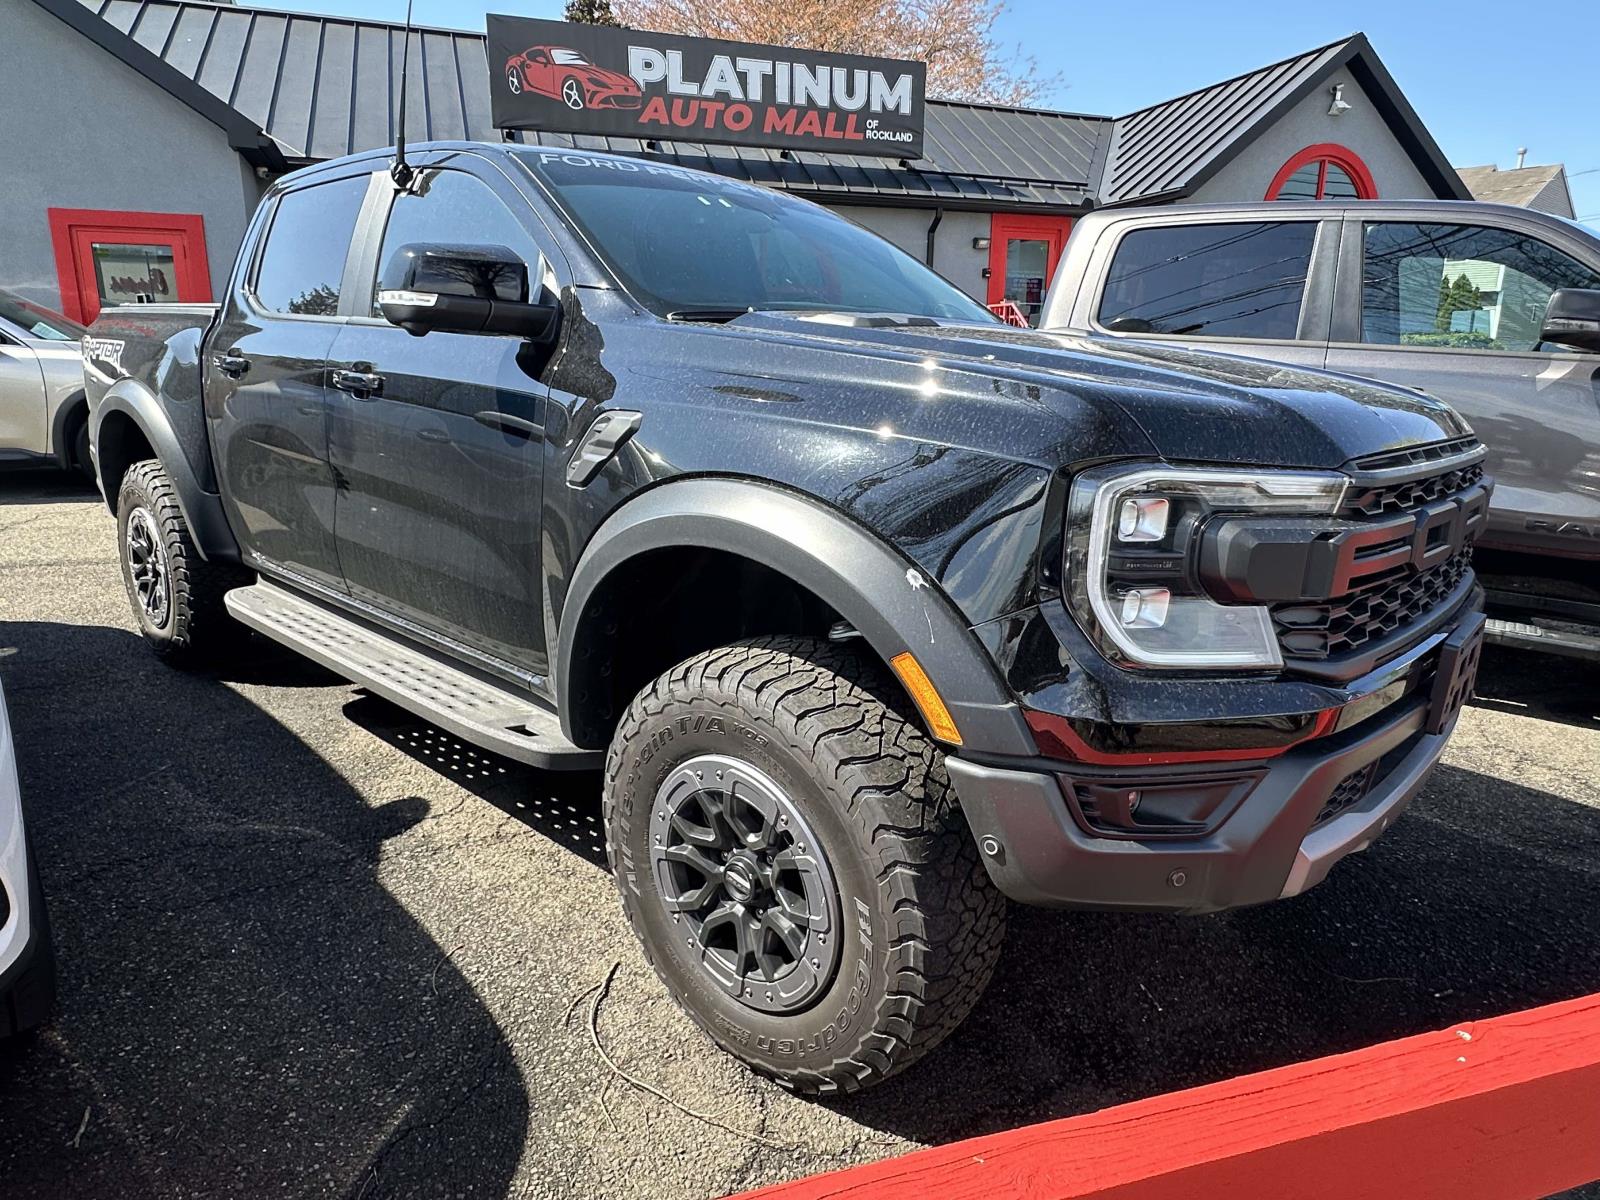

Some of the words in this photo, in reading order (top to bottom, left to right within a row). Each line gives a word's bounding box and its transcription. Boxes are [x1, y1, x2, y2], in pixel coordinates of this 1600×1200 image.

[627, 45, 913, 116] PLATINUM
[638, 96, 752, 132] AUTO
[763, 106, 864, 140] MALL
[865, 119, 879, 130] OF
[866, 130, 913, 143] ROCKLAND
[539, 153, 639, 172] FORD
[82, 336, 124, 366] RAPTOR
[675, 714, 726, 736] T/A
[756, 896, 874, 1058] BFGoodrich
